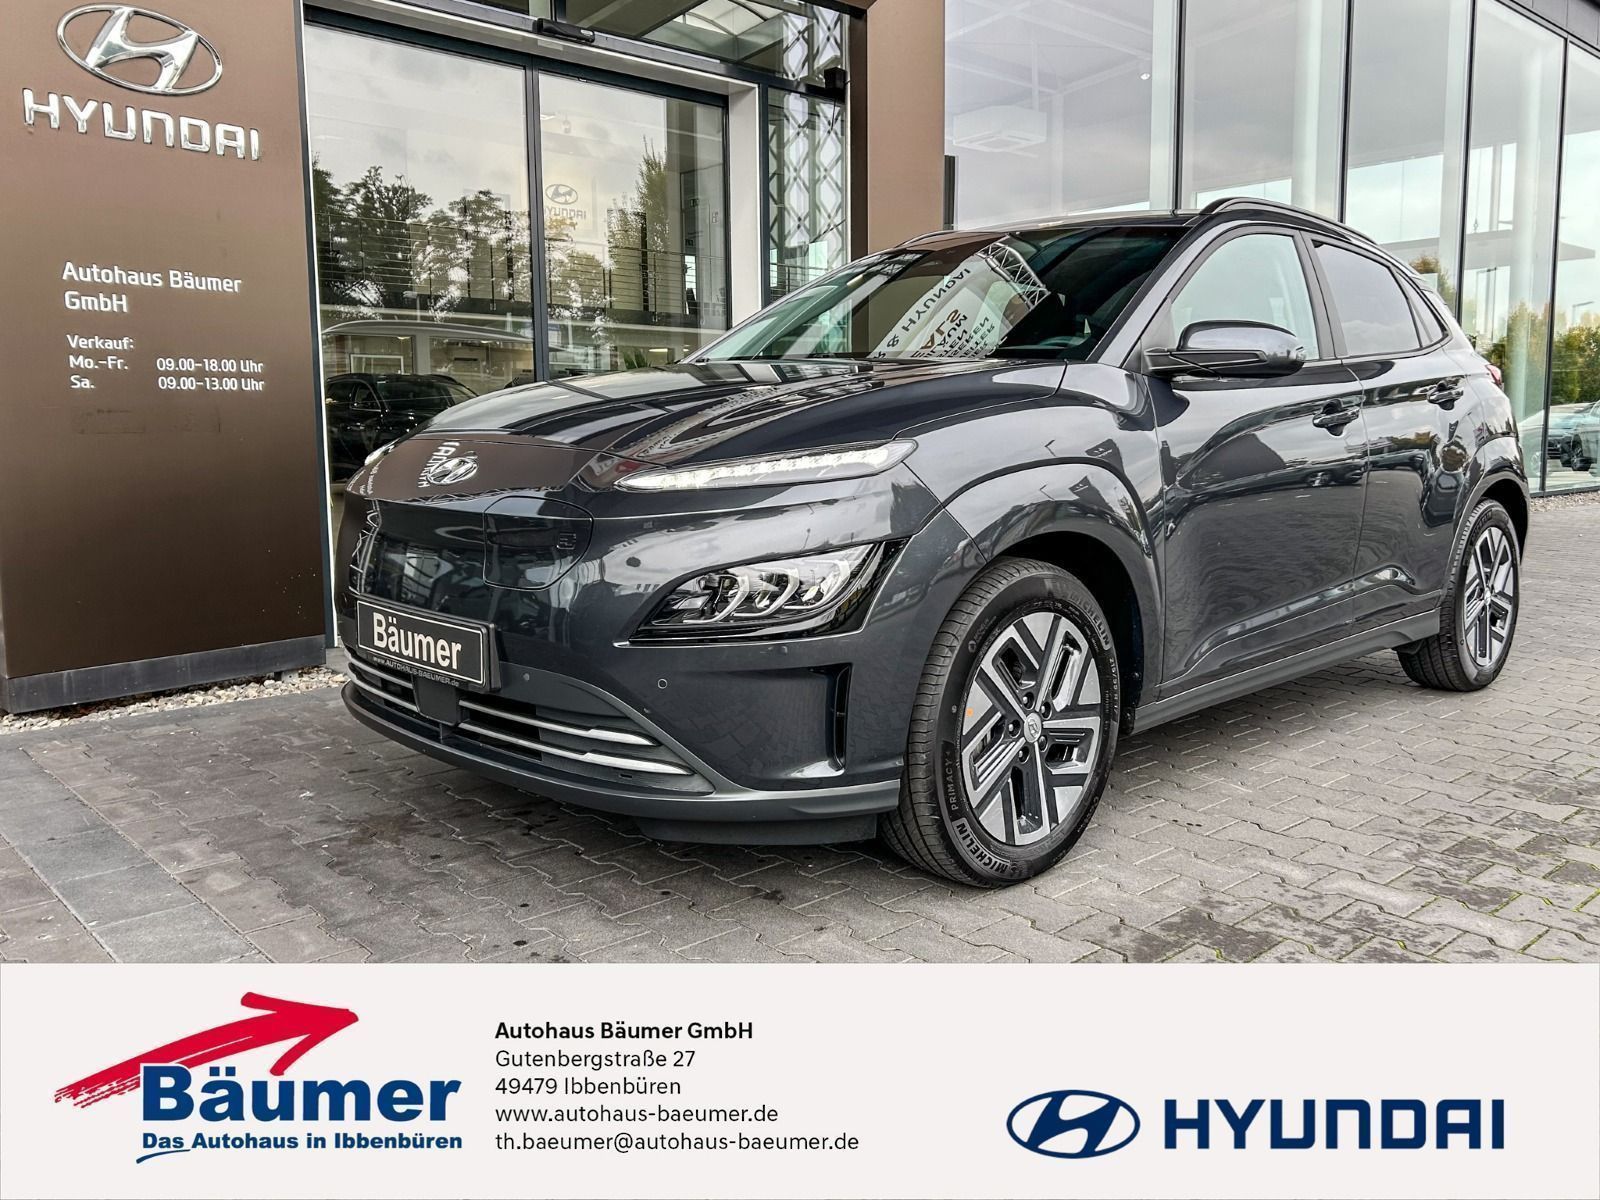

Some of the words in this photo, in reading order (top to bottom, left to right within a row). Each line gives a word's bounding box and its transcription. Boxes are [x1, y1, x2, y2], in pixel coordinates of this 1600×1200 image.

[22, 88, 261, 161] HYUNDAI
[544, 206, 587, 220] YUNDAI
[62, 262, 163, 287] Autohaus
[169, 270, 242, 293] Bäumer
[64, 291, 128, 313] GmbH
[66, 334, 135, 350] Verkauf:
[240, 359, 264, 373] Uhr
[70, 374, 96, 389] Sa.
[241, 378, 265, 391] Uhr
[373, 612, 462, 670] Bäumer
[945, 759, 959, 811] PRIMACY
[956, 822, 1009, 874] MICHELIN
